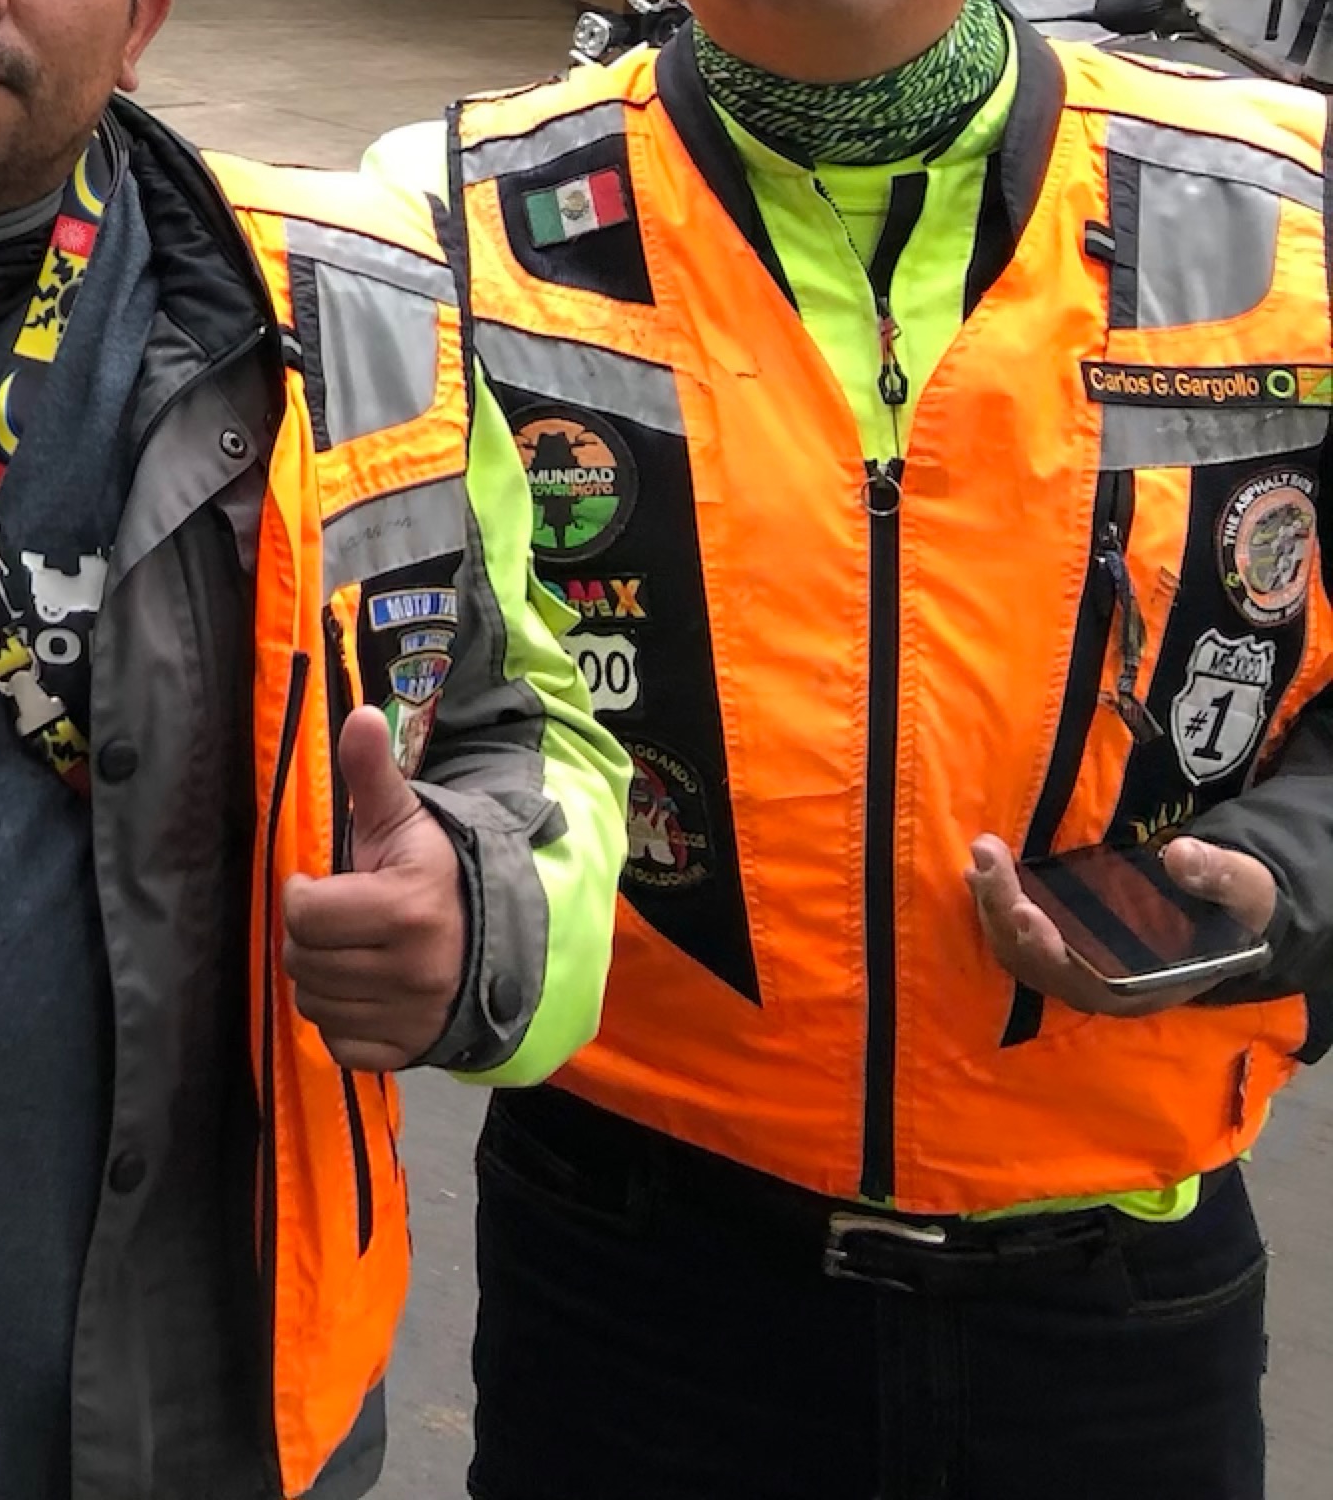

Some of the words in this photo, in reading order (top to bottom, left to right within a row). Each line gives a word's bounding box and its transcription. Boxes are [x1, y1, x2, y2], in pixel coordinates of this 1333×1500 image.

[1089, 367, 1151, 395] Carlos
[1175, 373, 1260, 402] Gargollo
[527, 469, 615, 484] MUNIDAD
[564, 649, 630, 694] 00
[1209, 650, 1263, 682] MEXICO
[1185, 690, 1235, 760] #1
